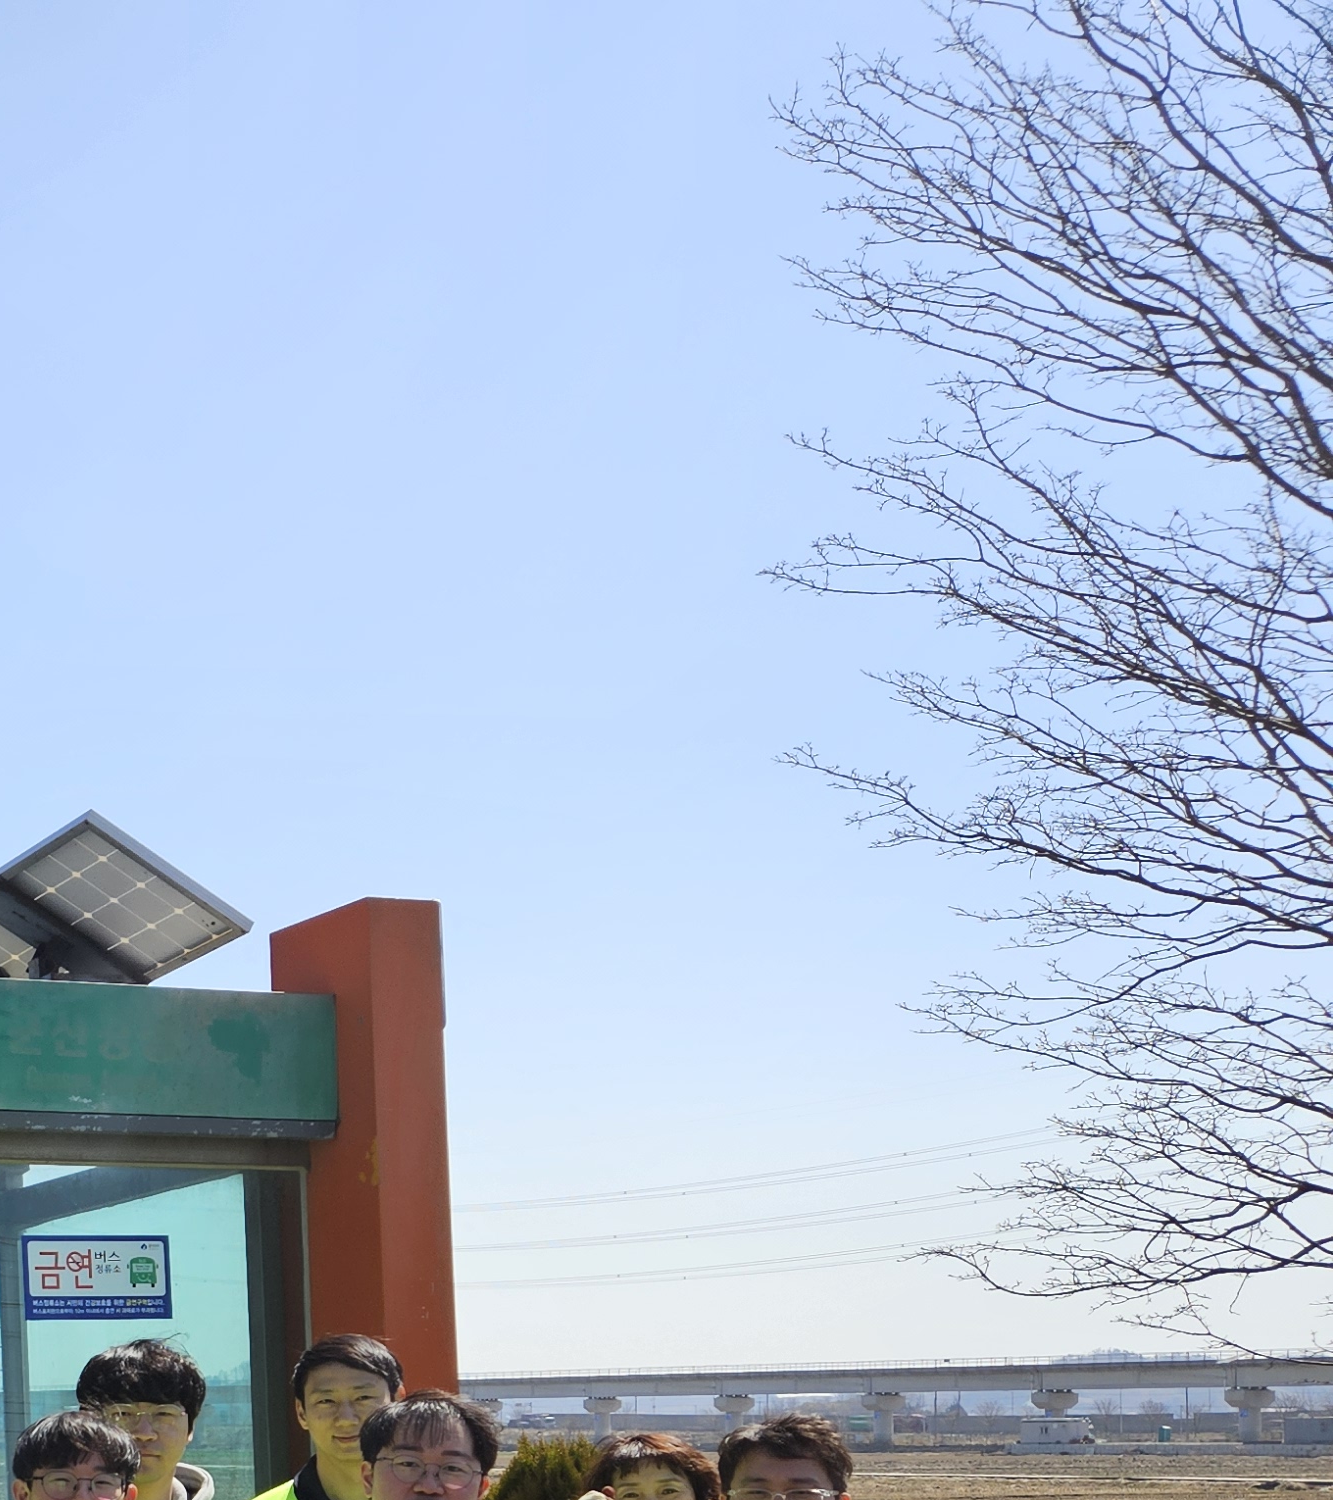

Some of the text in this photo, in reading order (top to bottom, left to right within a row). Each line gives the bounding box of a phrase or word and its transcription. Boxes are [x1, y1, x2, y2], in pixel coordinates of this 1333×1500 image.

[34, 1249, 121, 1289] 금연 버스
[95, 1264, 121, 1274] 정류소
